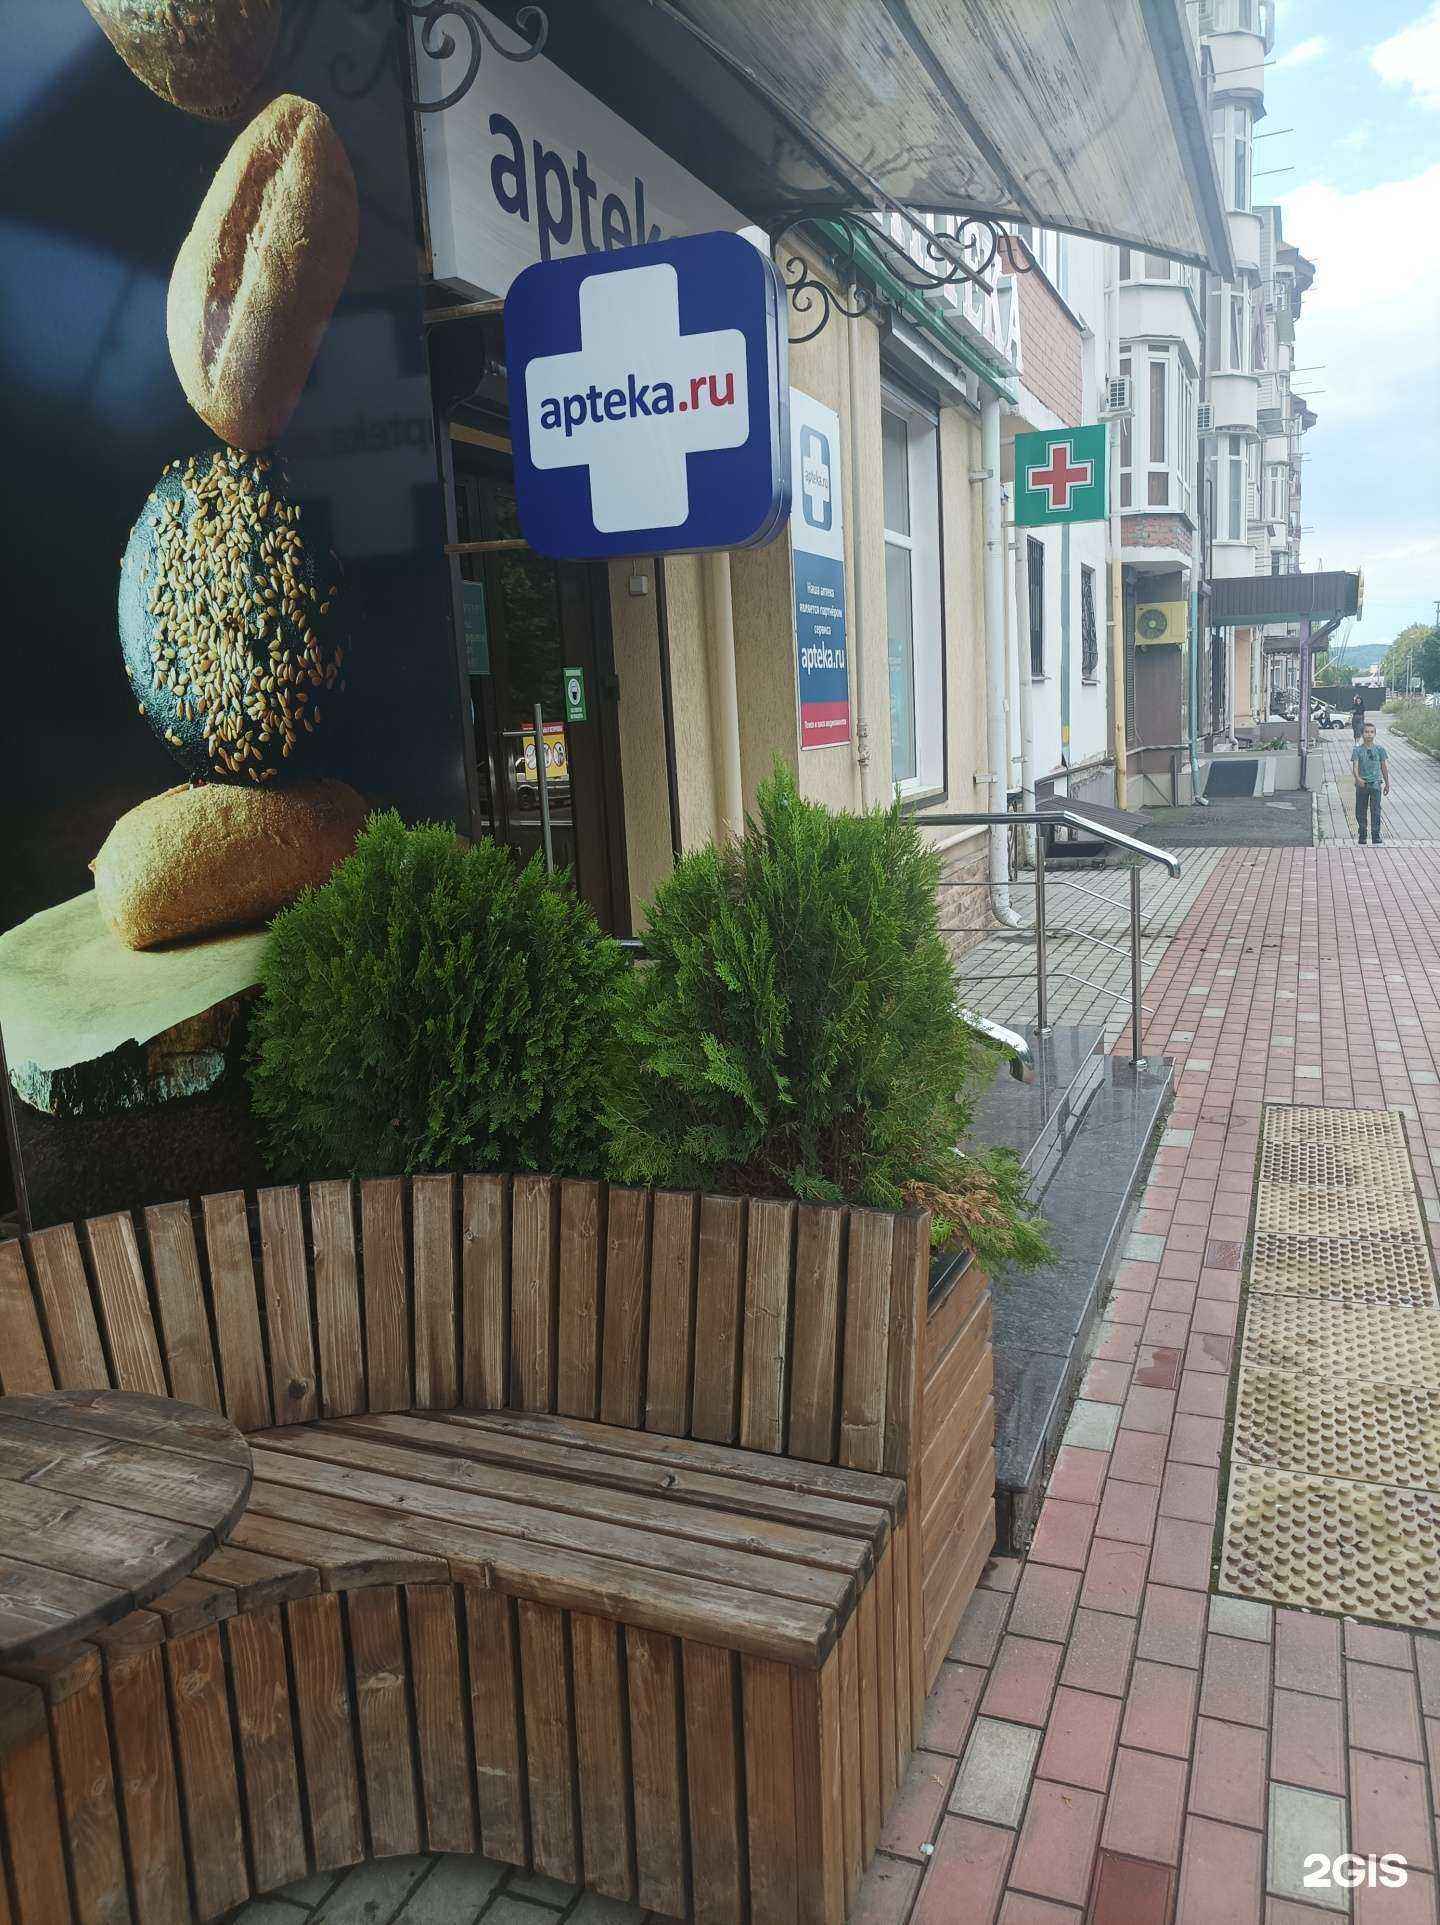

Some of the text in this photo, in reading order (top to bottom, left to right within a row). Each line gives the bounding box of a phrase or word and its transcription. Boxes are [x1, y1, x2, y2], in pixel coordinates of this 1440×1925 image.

[489, 112, 678, 262] aptek
[540, 373, 735, 437] apteka.ru
[801, 640, 844, 675] apteka.ru
